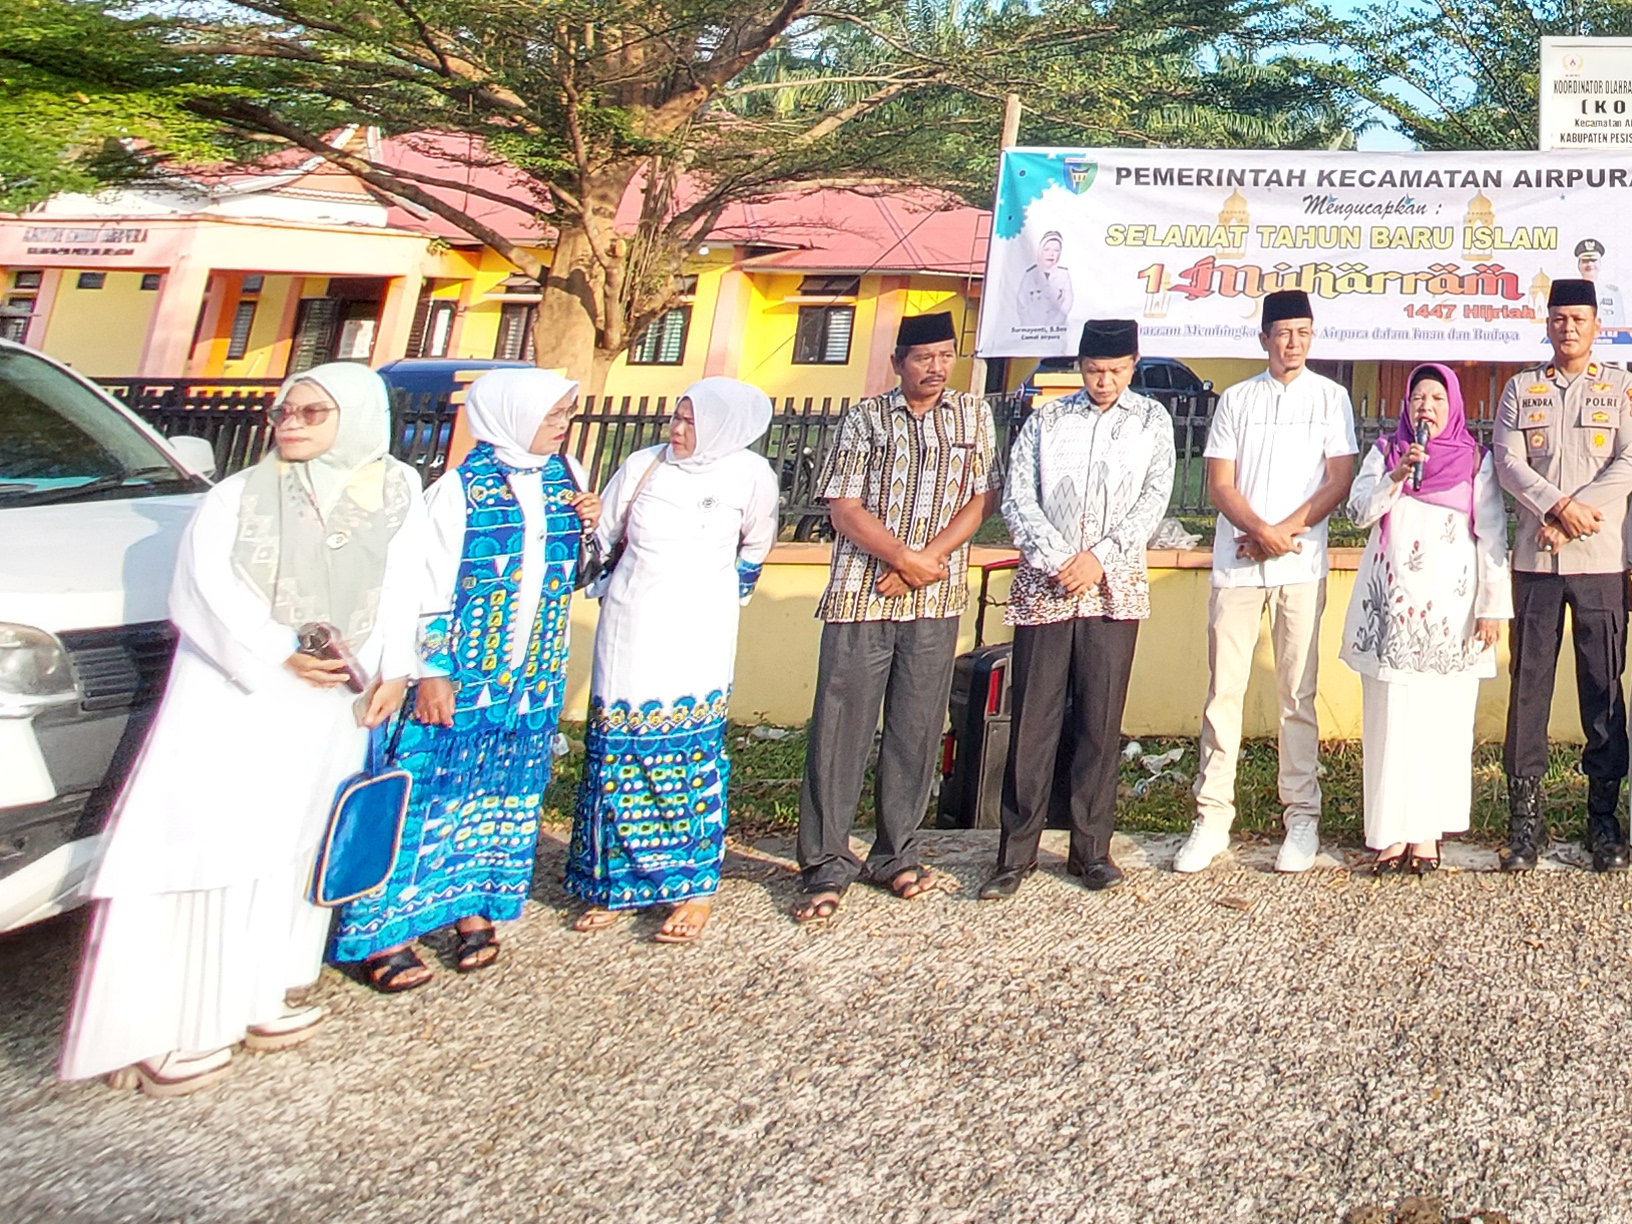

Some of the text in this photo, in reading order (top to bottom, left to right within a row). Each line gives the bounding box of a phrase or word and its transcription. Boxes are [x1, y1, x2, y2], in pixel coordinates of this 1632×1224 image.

[1553, 80, 1603, 94] KOORDINATOR
[1574, 118, 1622, 128] Kecamatan
[1560, 133, 1608, 143] KABUPATEN
[1115, 166, 1307, 188] PEMERINTAH
[1317, 169, 1501, 188] KECAMATAN
[1302, 193, 1427, 221] Mengucapkan
[1105, 224, 1558, 250] SELAMAT TAHUN BARU ISLAM
[1137, 263, 1165, 294] 1
[1403, 303, 1536, 322] 1447 Hijriah
[1319, 326, 1369, 342] Airpura
[1522, 398, 1553, 408] HENDRA
[1585, 397, 1617, 407] POLRI
